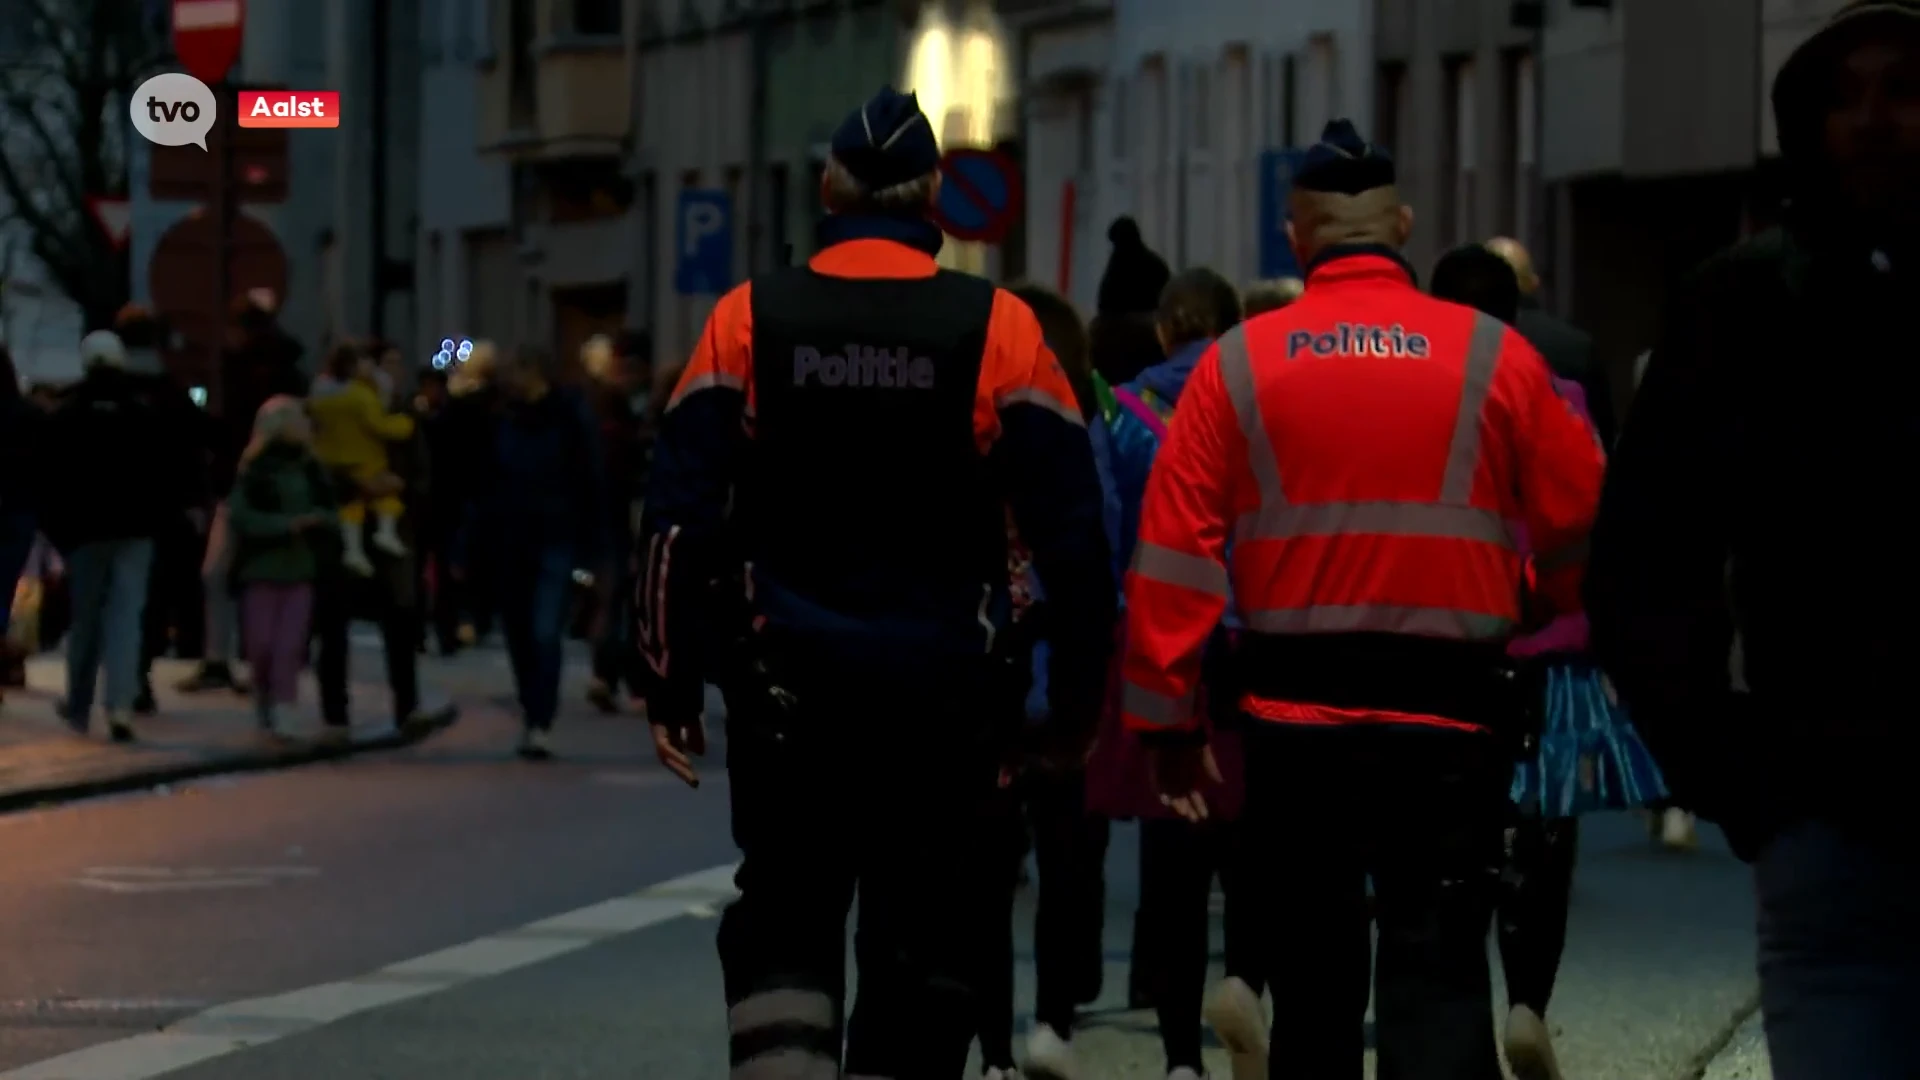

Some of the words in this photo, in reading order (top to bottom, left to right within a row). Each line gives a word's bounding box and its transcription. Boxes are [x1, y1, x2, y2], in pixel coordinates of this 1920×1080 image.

[685, 201, 723, 257] P
[1287, 322, 1431, 360] Politie
[793, 343, 936, 390] Politie
